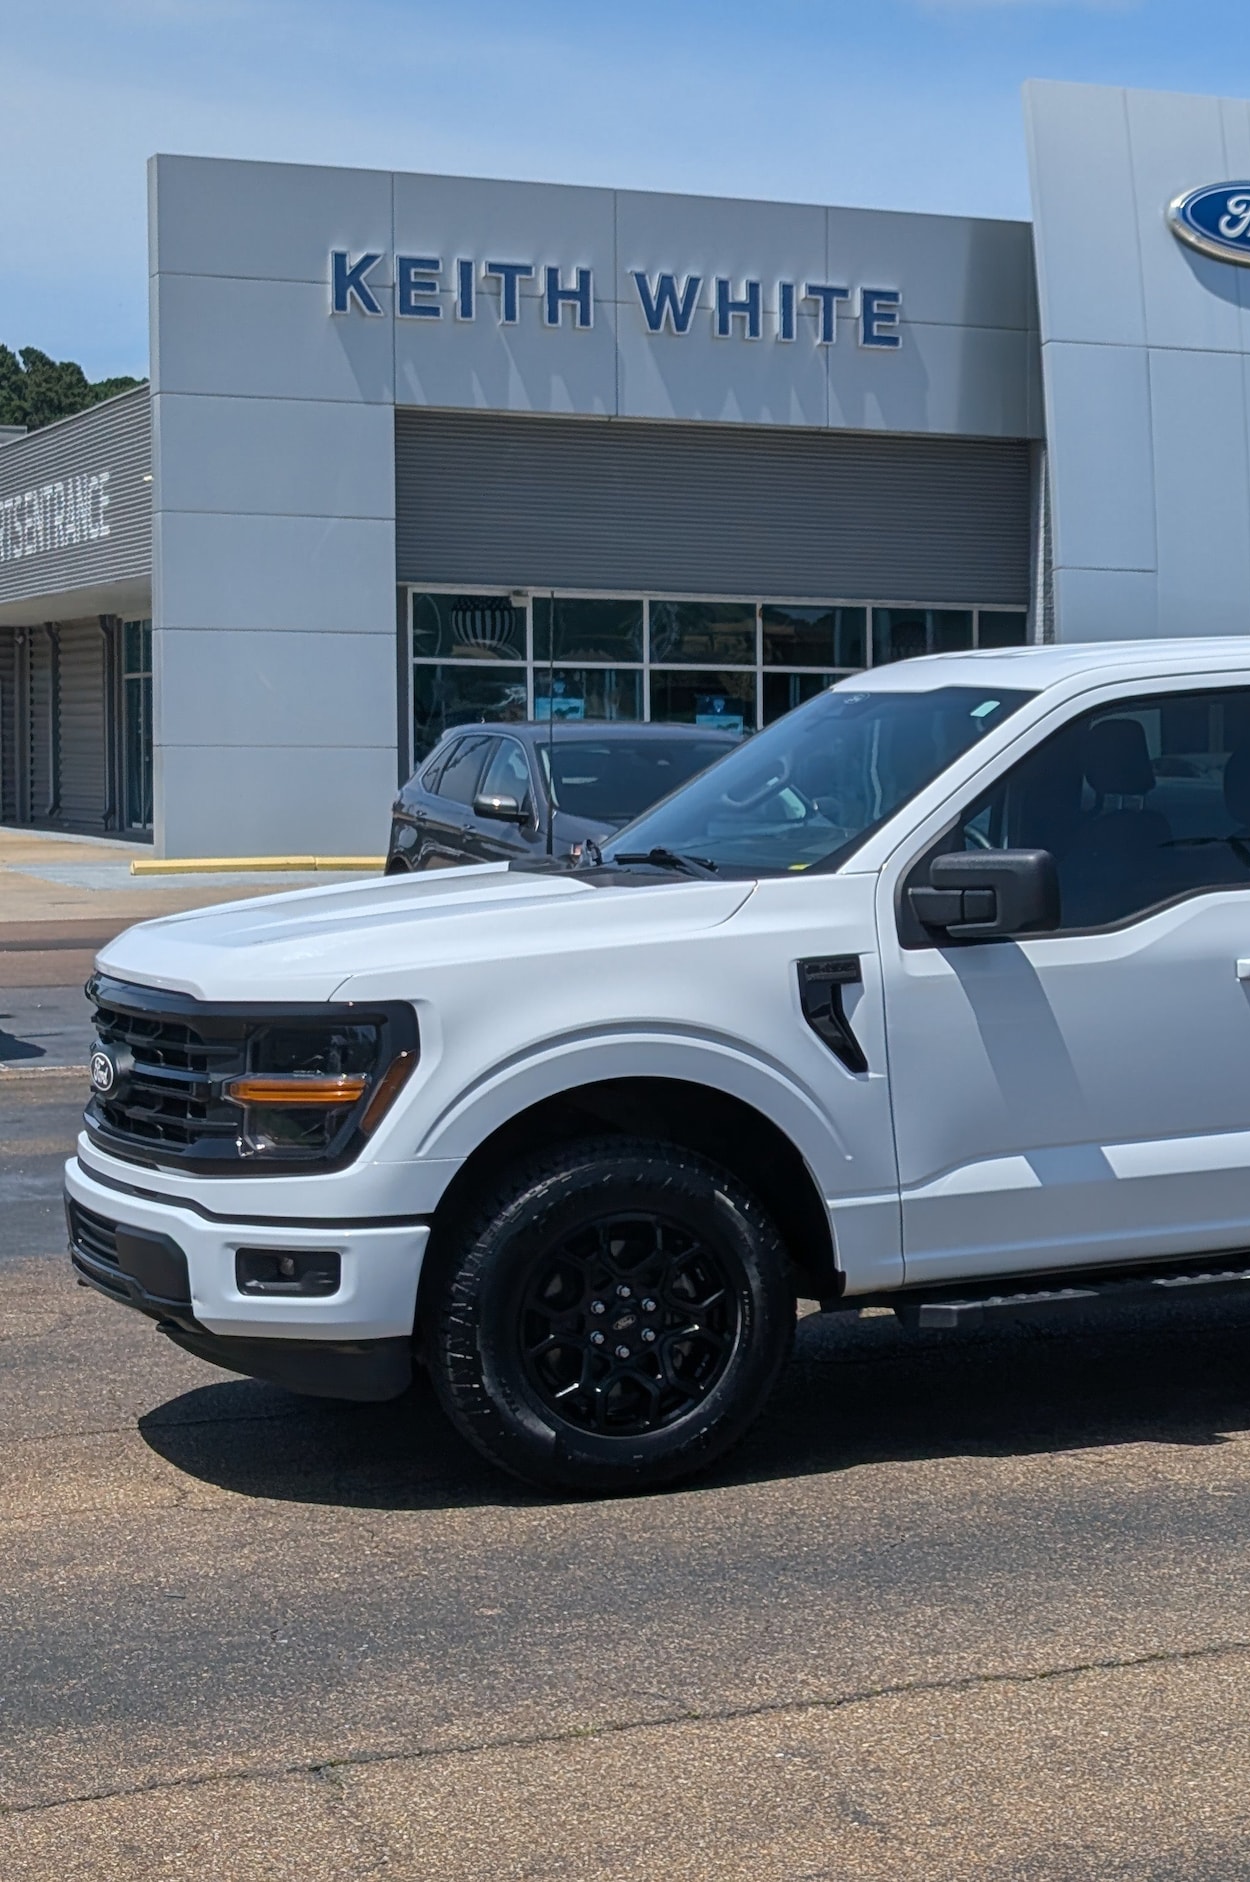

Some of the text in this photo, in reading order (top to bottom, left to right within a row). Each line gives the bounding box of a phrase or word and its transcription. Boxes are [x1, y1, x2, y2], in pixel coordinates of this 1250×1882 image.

[330, 250, 903, 350] KEITH WHITE
[94, 1056, 109, 1085] Ford
